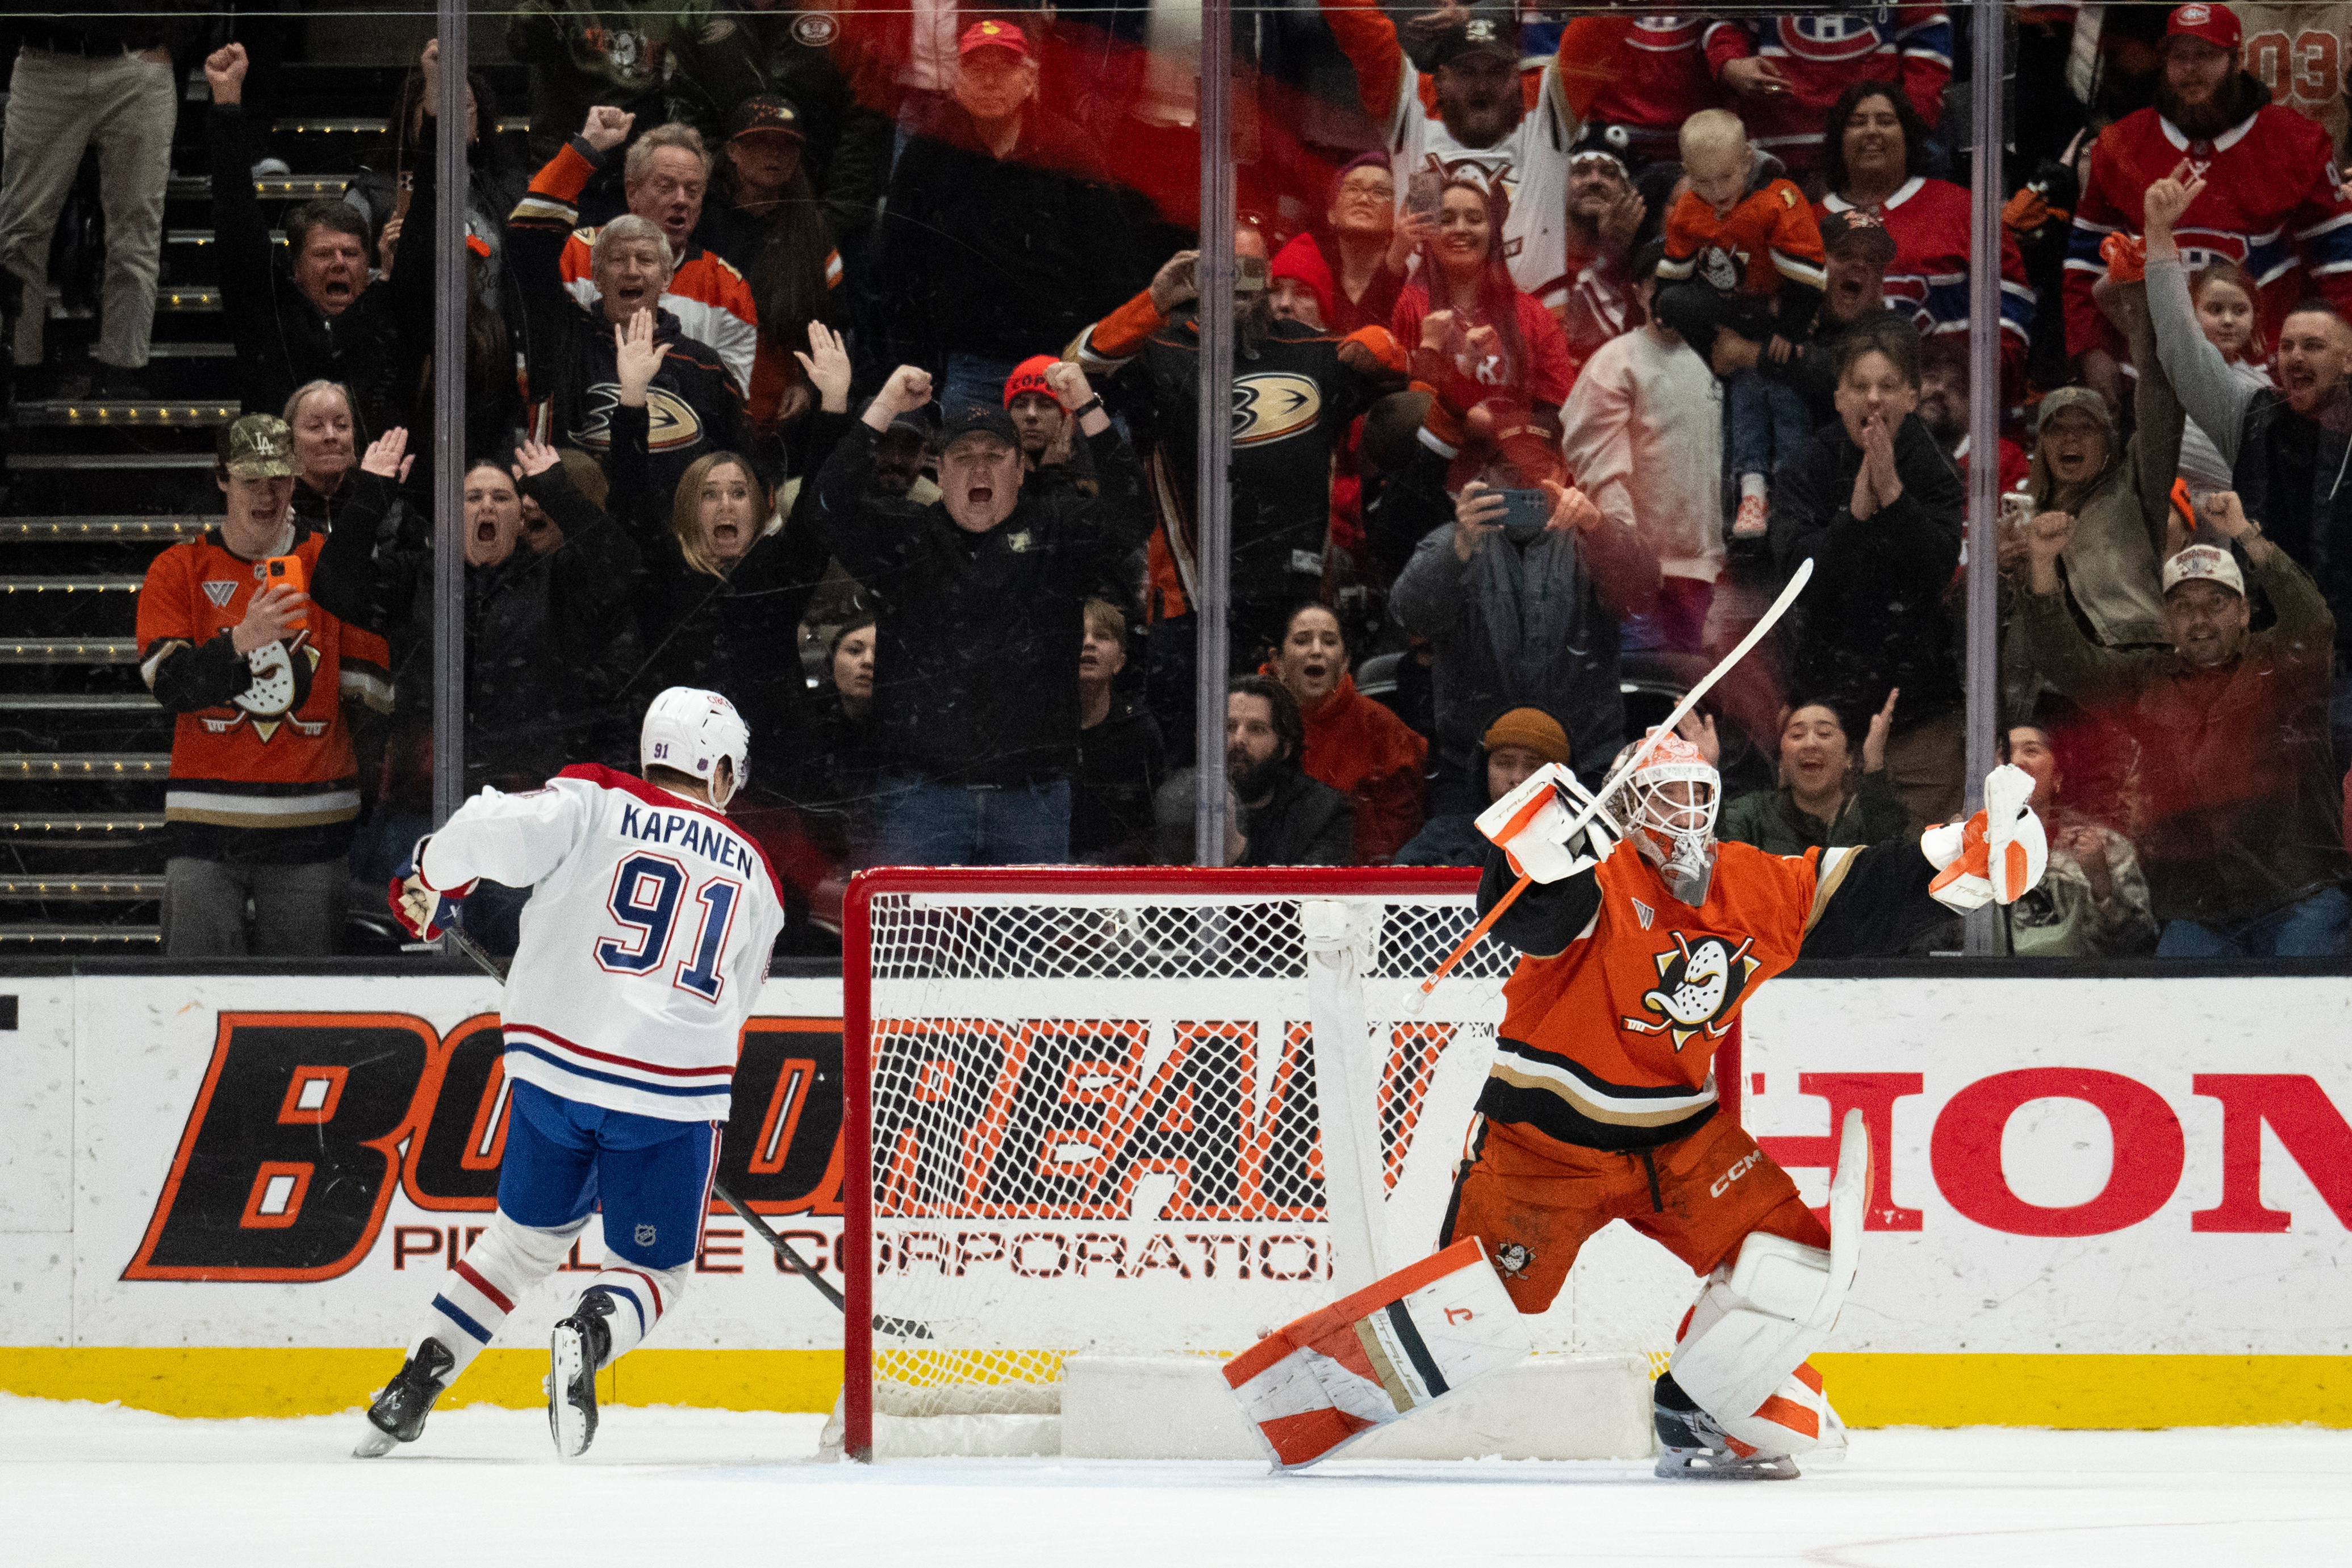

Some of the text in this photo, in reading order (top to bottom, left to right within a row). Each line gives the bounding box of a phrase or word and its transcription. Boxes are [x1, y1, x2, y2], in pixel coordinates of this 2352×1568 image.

[255, 432, 274, 455] LA
[654, 743, 669, 759] 91
[620, 802, 753, 881] KAPANEN
[595, 850, 743, 1005] 91
[118, 1009, 1464, 1283] BODREAU
[1710, 1149, 1763, 1198] CCM
[774, 1230, 1334, 1281] CORPORATIO
